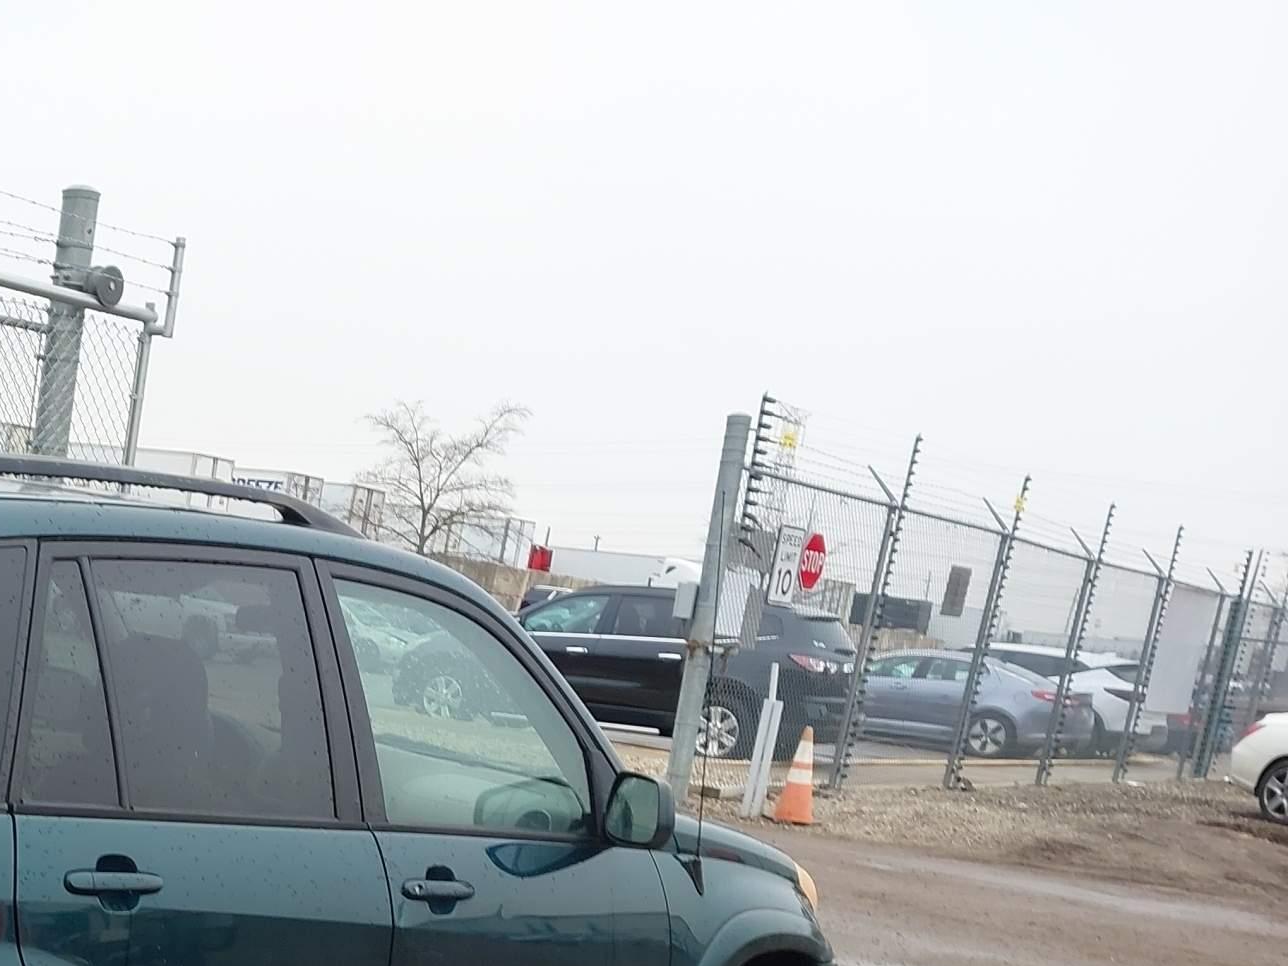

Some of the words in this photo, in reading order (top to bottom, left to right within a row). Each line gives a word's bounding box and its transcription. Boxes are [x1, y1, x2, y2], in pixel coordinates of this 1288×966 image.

[781, 533, 802, 547] SPEED
[780, 551, 797, 562] LIMIT
[801, 549, 825, 573] STOP
[775, 567, 792, 596] 10
